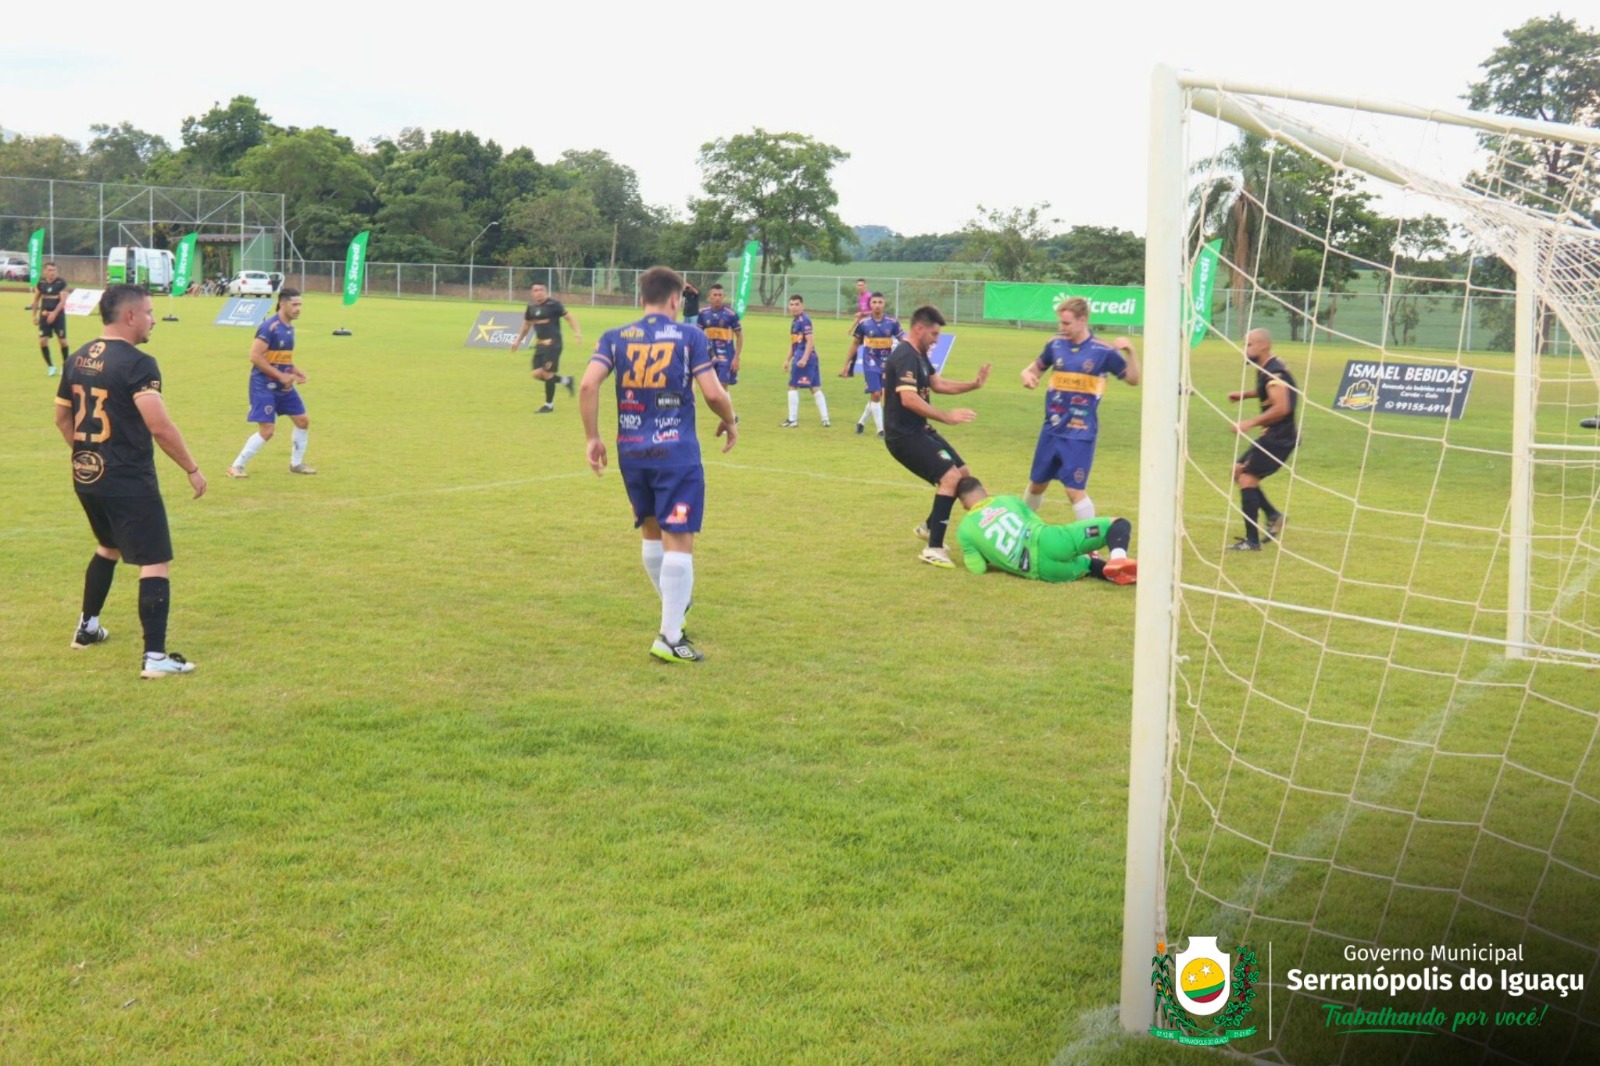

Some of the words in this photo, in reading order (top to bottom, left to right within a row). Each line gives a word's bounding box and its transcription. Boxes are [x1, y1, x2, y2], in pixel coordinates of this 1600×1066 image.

[178, 242, 190, 276] Sicredi
[349, 243, 361, 281] Sicredi
[1196, 257, 1211, 312] Sicredi
[1085, 297, 1137, 315] icredi
[622, 342, 676, 389] 32
[1348, 363, 1401, 381] ISMAEL
[1404, 366, 1468, 384] BEBIDAS
[71, 384, 111, 443] 23
[984, 512, 1024, 556] 20
